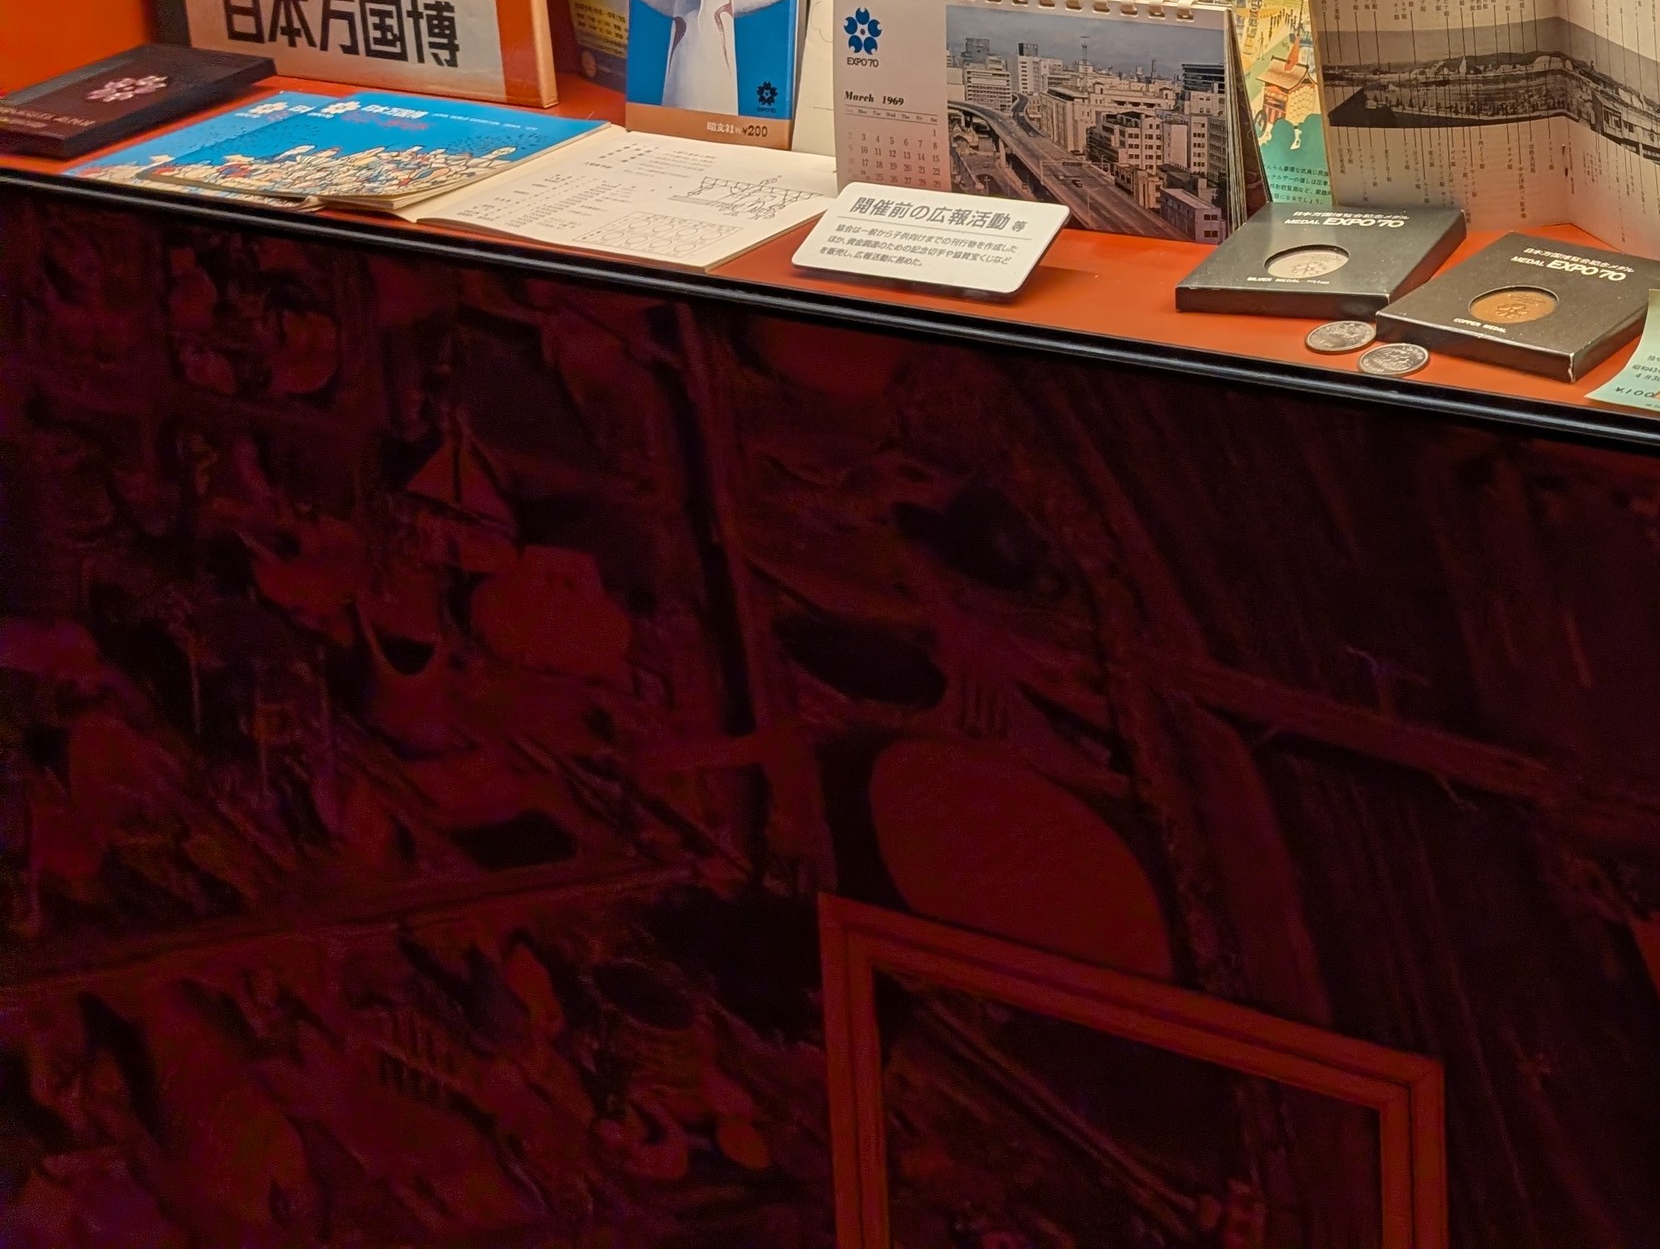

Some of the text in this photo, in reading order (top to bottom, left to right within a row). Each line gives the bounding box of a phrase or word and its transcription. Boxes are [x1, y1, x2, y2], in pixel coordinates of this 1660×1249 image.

[844, 90, 905, 106] March 1969
[849, 196, 1012, 232] 開催前の広報活動
[1510, 255, 1545, 267] MEDAL
